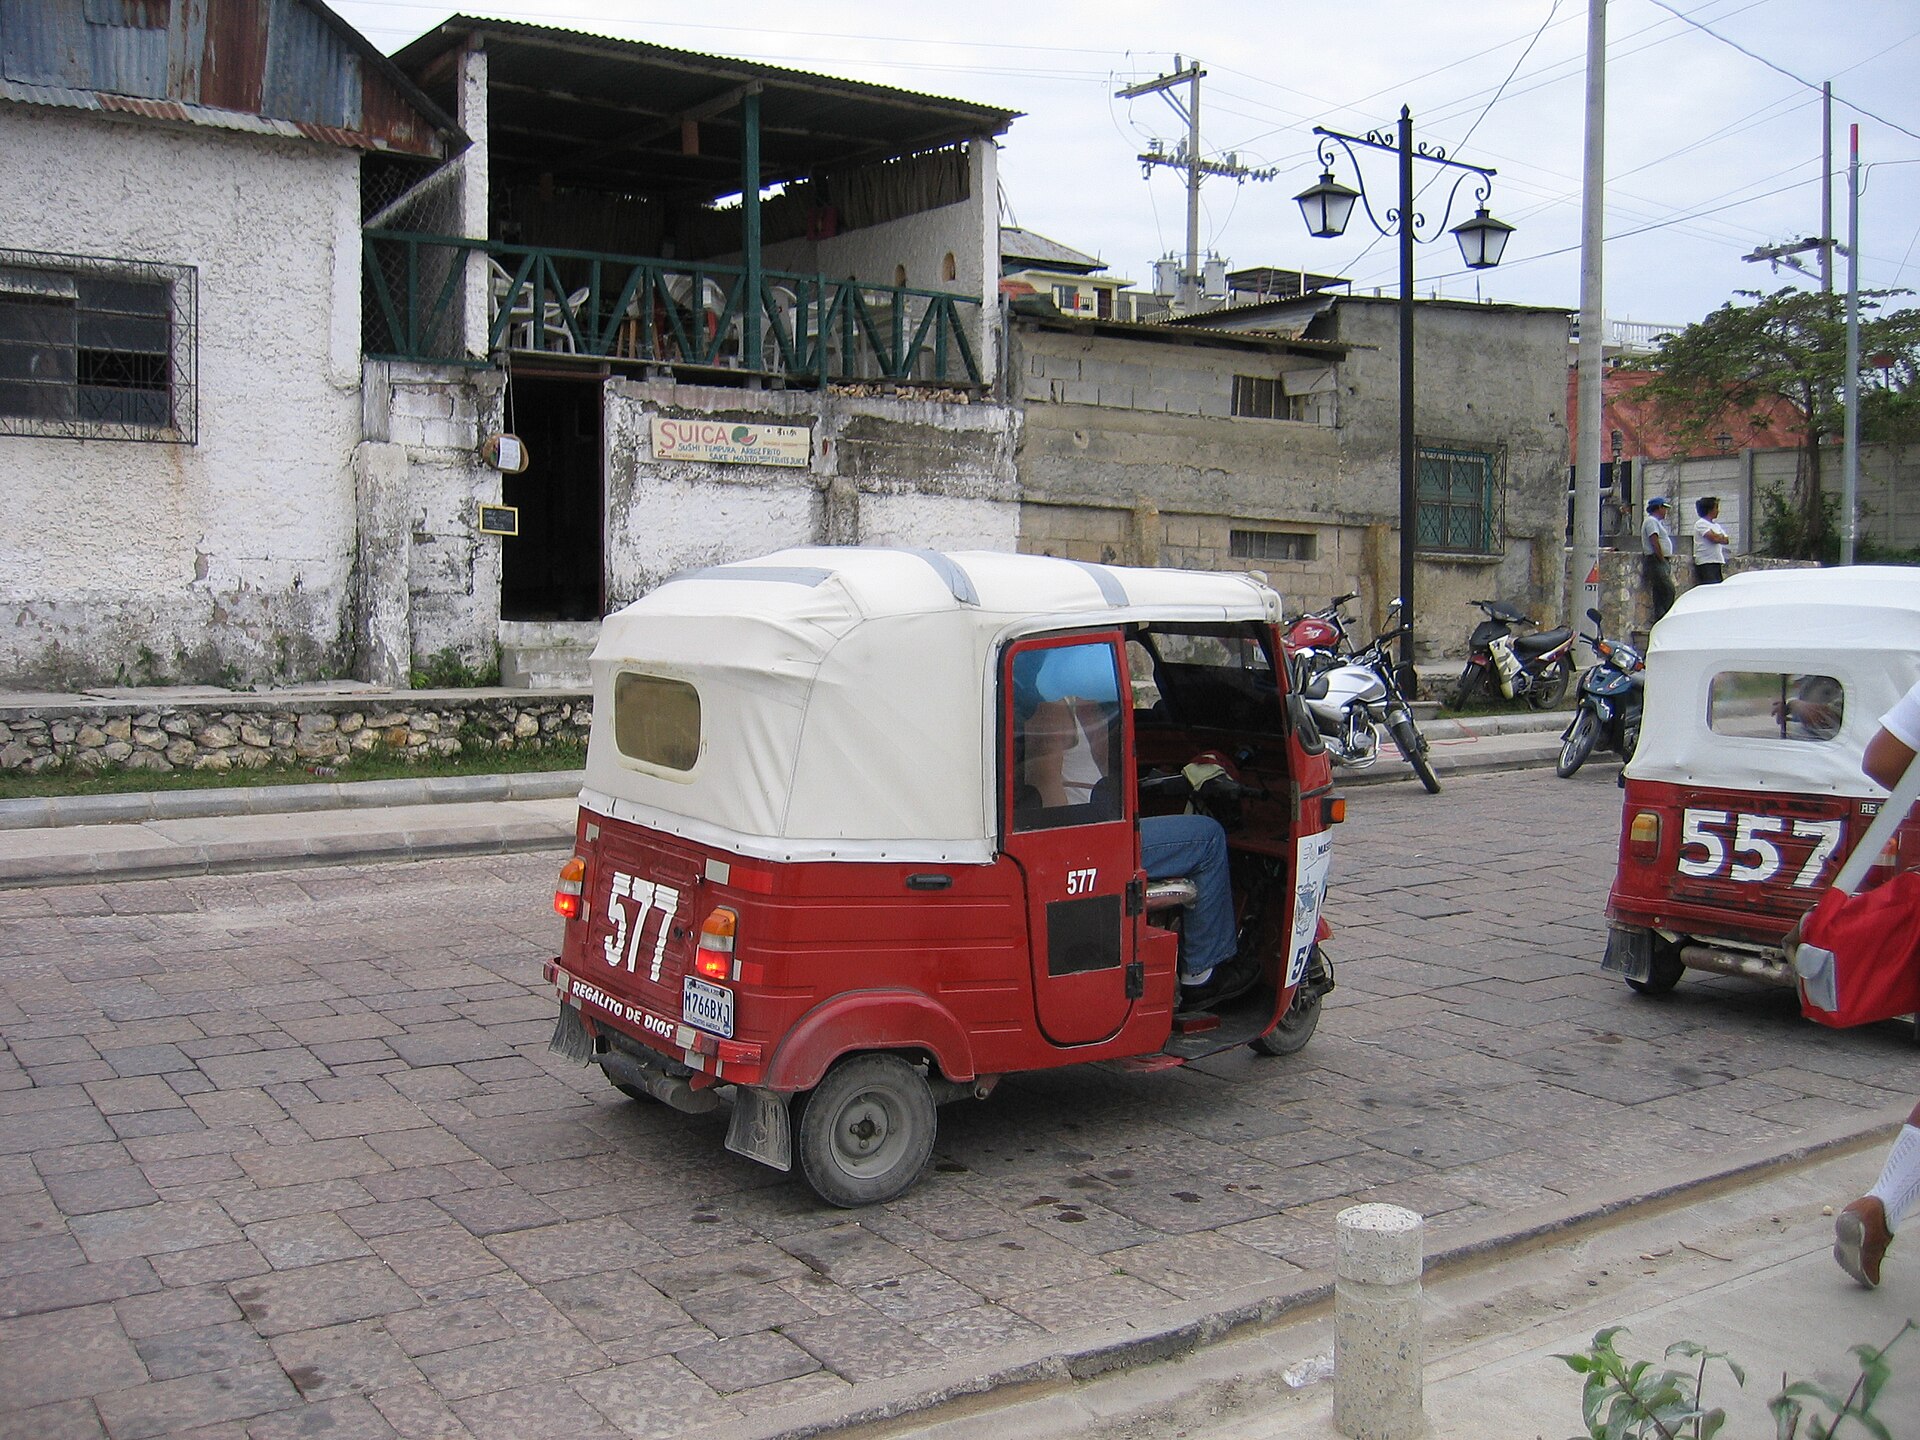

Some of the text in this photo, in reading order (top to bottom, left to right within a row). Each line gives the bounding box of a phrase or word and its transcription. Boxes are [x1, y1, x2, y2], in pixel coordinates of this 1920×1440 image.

[660, 421, 729, 450] SUICA
[704, 445, 736, 453] TEMPURA
[1677, 808, 1842, 887] 557
[1066, 868, 1097, 895] 577
[604, 871, 680, 983] 577
[572, 981, 674, 1038] REGALITO DE DIOS
